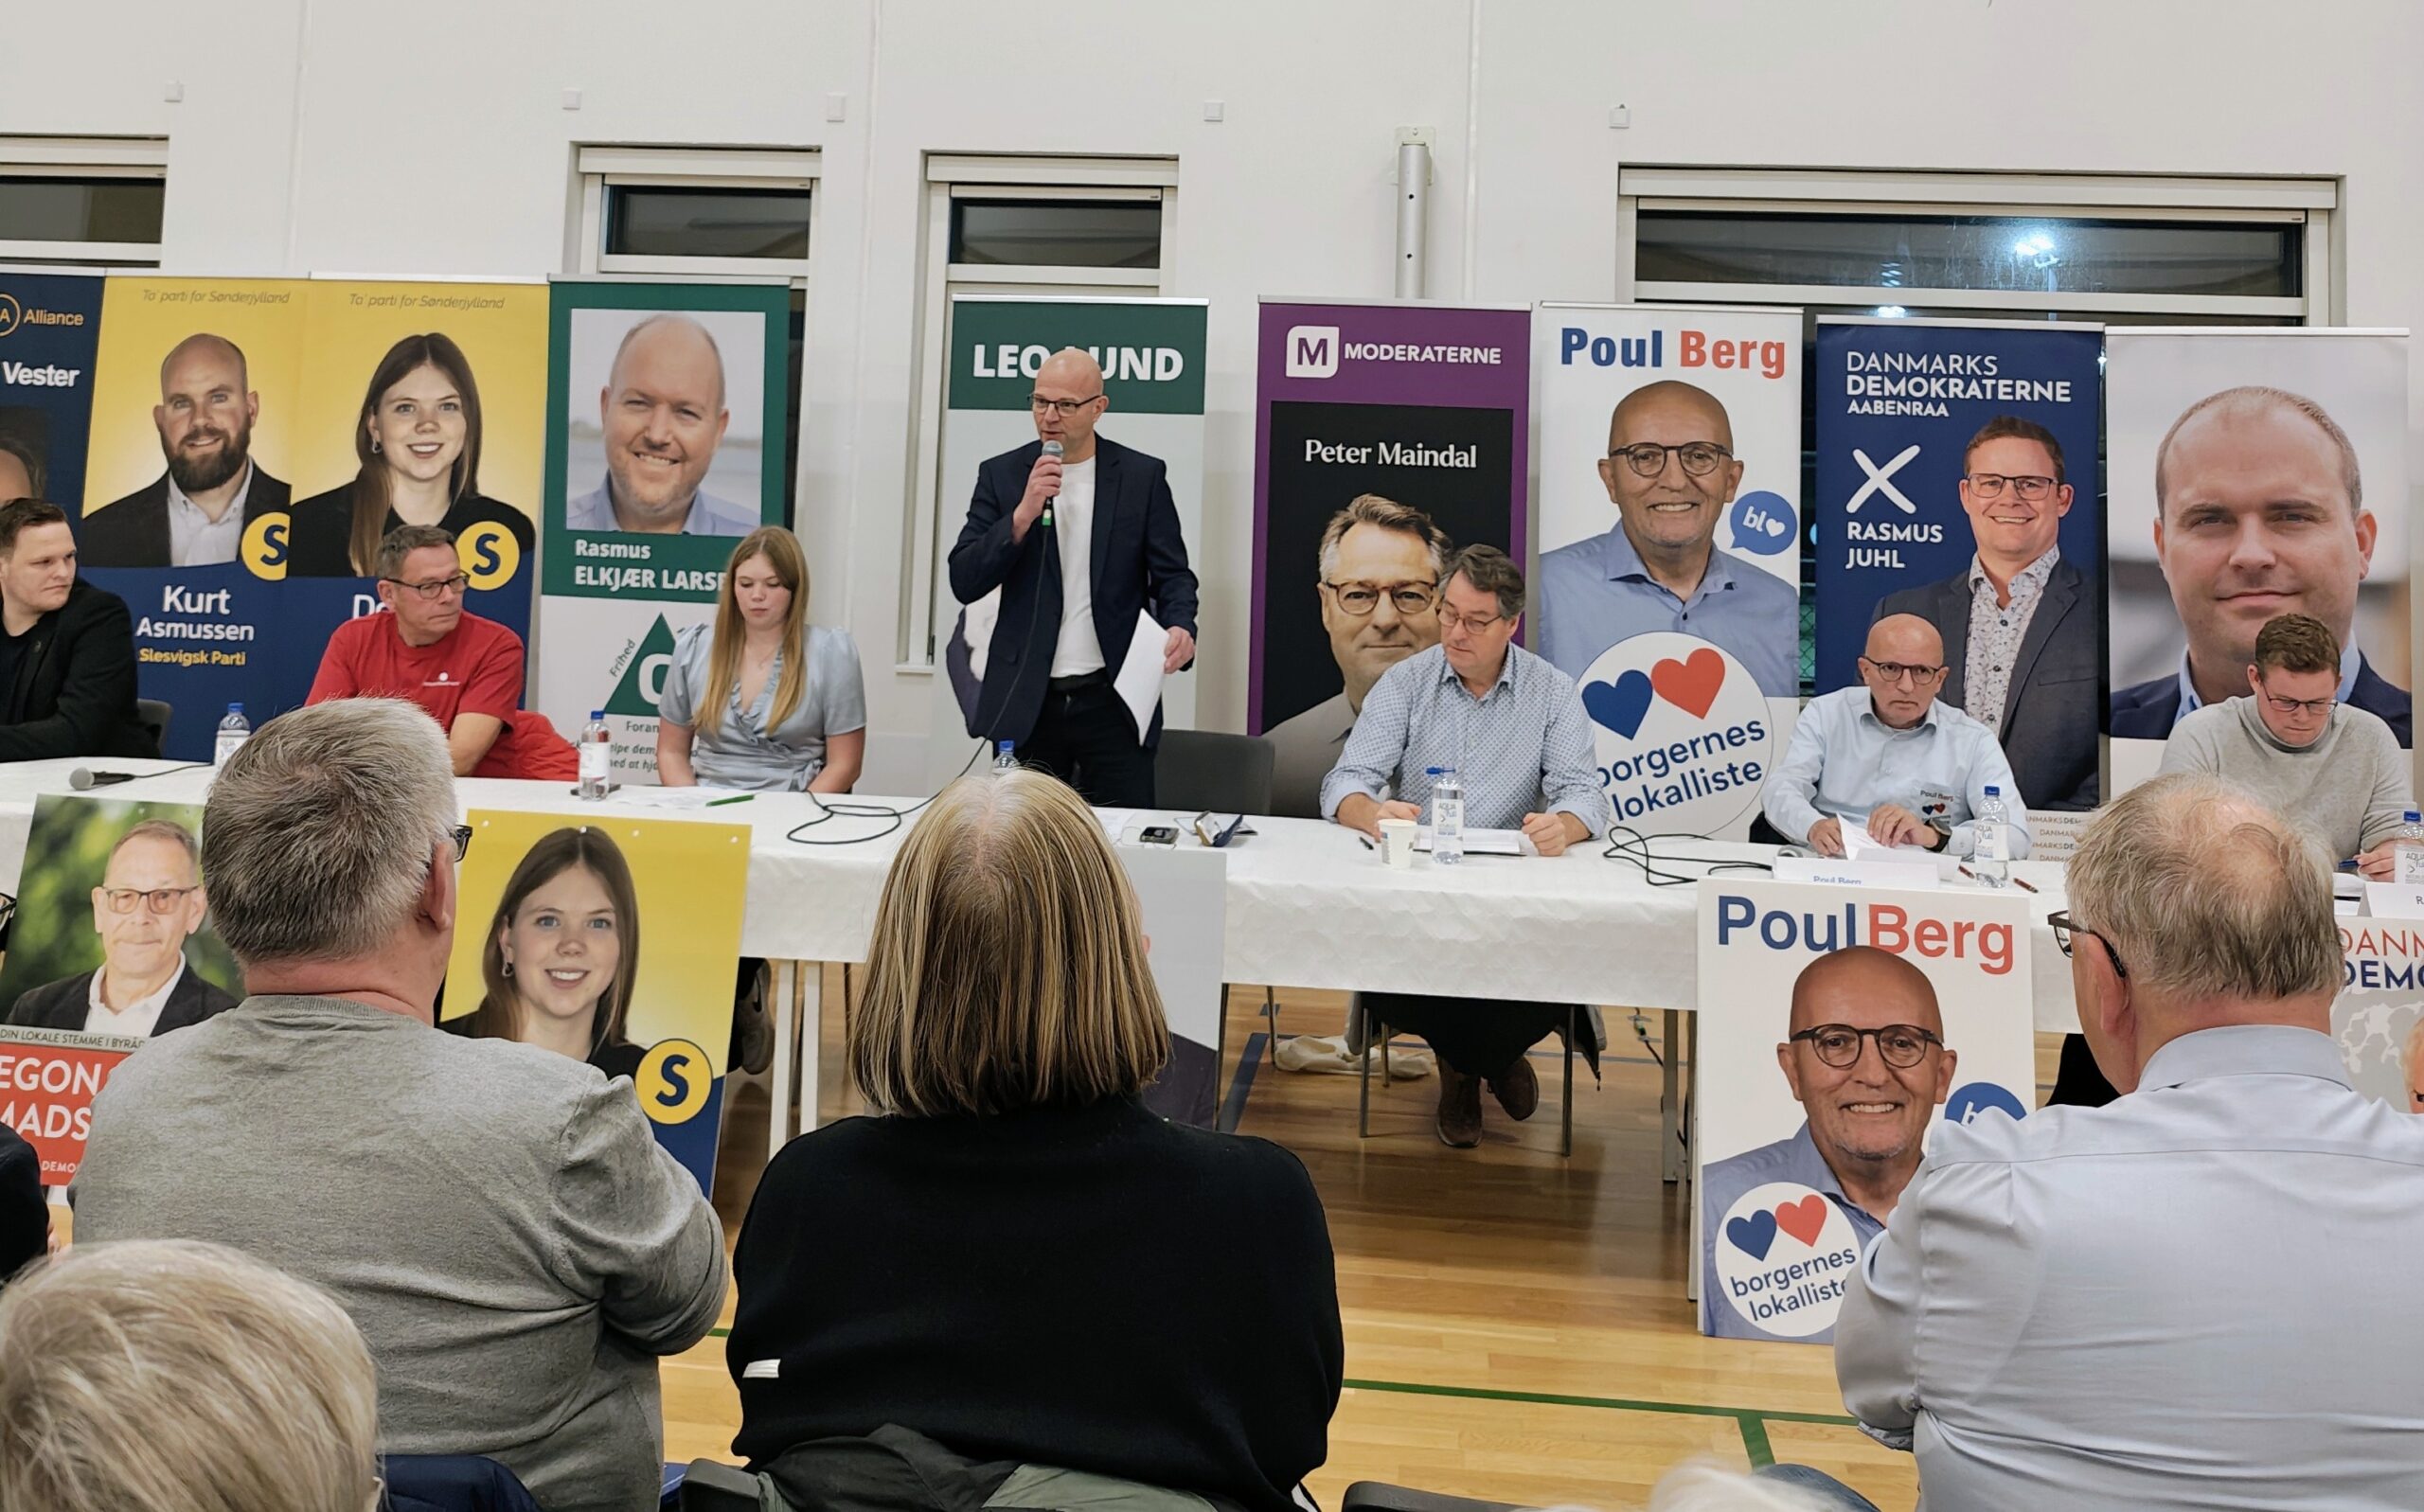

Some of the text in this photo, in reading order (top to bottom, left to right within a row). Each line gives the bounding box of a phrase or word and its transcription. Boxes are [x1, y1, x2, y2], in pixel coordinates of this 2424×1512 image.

[160, 291, 187, 303] parti
[189, 291, 205, 304] for
[368, 294, 396, 308] parti
[400, 294, 417, 309] for
[419, 295, 505, 311] Sønderjylland
[24, 309, 84, 326] Alliance
[973, 345, 1184, 381] LEO UND
[1345, 343, 1502, 365] MODERATERNE
[1561, 327, 1786, 380] Poul Berg
[1846, 351, 1998, 376] DANMARKS
[2, 361, 80, 387] Vester
[1846, 375, 2072, 402] DEMOKRATERNE
[1847, 400, 1950, 417] AABENRAA
[1305, 439, 1477, 469] Peter Maindal
[260, 525, 288, 565] S
[1847, 521, 1943, 543] RASMUS
[472, 533, 501, 576] S
[575, 539, 651, 560] Rasmus
[1845, 548, 1906, 569] JUHL
[575, 565, 655, 592] ELKJÆR
[162, 585, 231, 615] Kurt
[135, 616, 255, 642] Asmussen
[139, 648, 246, 667] Slesvigsk Parti
[609, 638, 636, 678] Frihed
[1612, 760, 1762, 822] lokalliste
[1718, 896, 2014, 975] Poul Berg
[2344, 960, 2424, 990] DEM
[0, 1028, 19, 1040] DIN
[21, 1030, 59, 1042] LOKALE
[62, 1034, 103, 1046] STEMME
[0, 1055, 102, 1096] EGON
[655, 1054, 690, 1107] S
[1730, 1248, 1856, 1297] borgernes
